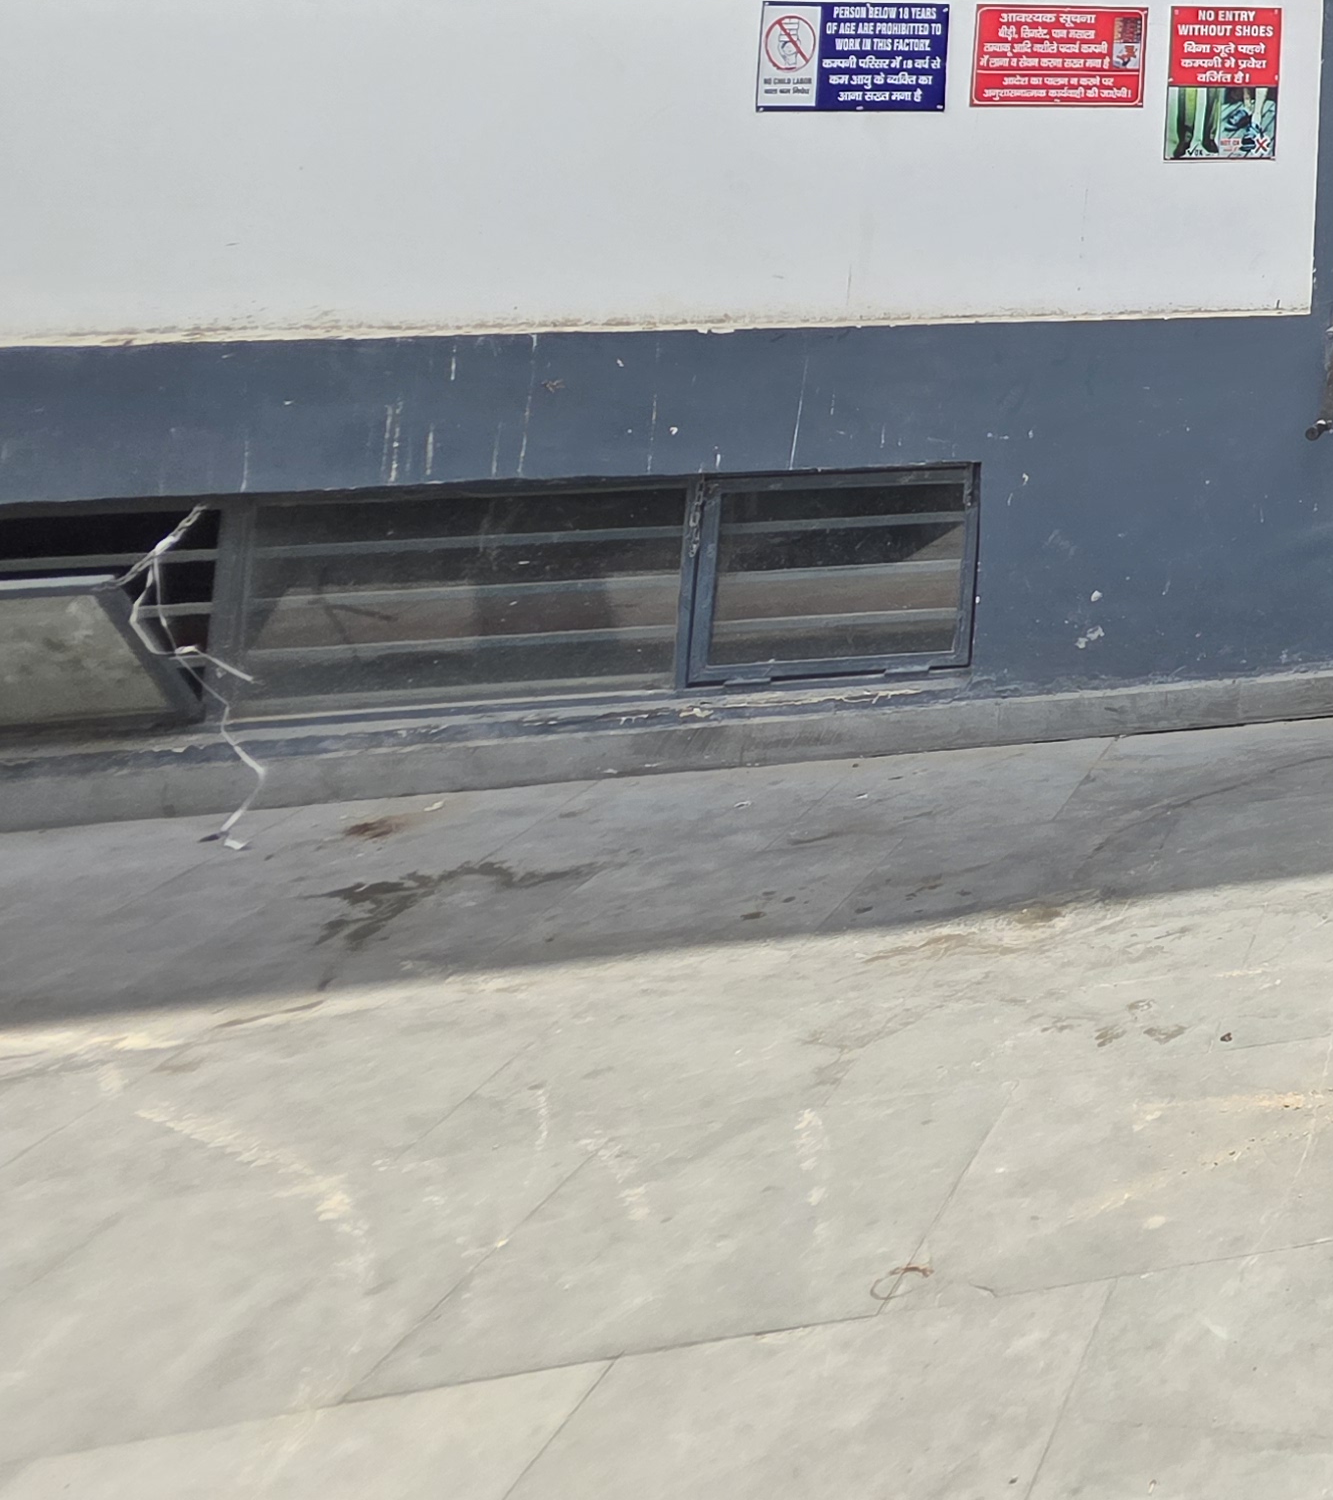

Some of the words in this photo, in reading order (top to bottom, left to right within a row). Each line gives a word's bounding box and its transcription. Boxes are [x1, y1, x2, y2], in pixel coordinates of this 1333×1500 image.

[833, 6, 867, 18] PERSON
[868, 7, 897, 19] BELOW
[899, 8, 910, 19] 18
[911, 8, 937, 19] YEARS
[1198, 10, 1215, 21] NO
[1218, 10, 1255, 22] ENTRY
[999, 13, 1057, 23] आवश्यक
[1059, 13, 1096, 27] सूचना
[826, 23, 838, 34] OF
[839, 23, 857, 34] AGE
[857, 23, 874, 34] ARE
[876, 23, 929, 35] PROHIBITTED
[931, 24, 942, 35] TO
[1178, 24, 1232, 36] WITHOUT
[1235, 25, 1274, 37] SHOES
[835, 38, 861, 51] WORK
[862, 38, 872, 50] IN
[873, 38, 892, 51] THIS
[1183, 41, 1211, 53] बिना
[1212, 42, 1236, 57] जूते
[1237, 42, 1266, 55] पहने
[822, 55, 857, 69] कम्पनी
[890, 56, 903, 69] में
[903, 60, 913, 69] 18
[914, 56, 930, 69] वर्ष
[931, 56, 941, 69] से
[1181, 56, 1222, 68] कम्पनी
[1238, 57, 1267, 70] प्रवेश
[828, 74, 849, 84] कम
[850, 74, 872, 89] आयु
[873, 72, 885, 85] के
[918, 75, 933, 85] का
[837, 91, 863, 101] आना
[864, 91, 890, 101] सख्त
[891, 91, 912, 101] मना
[913, 88, 923, 102] है
